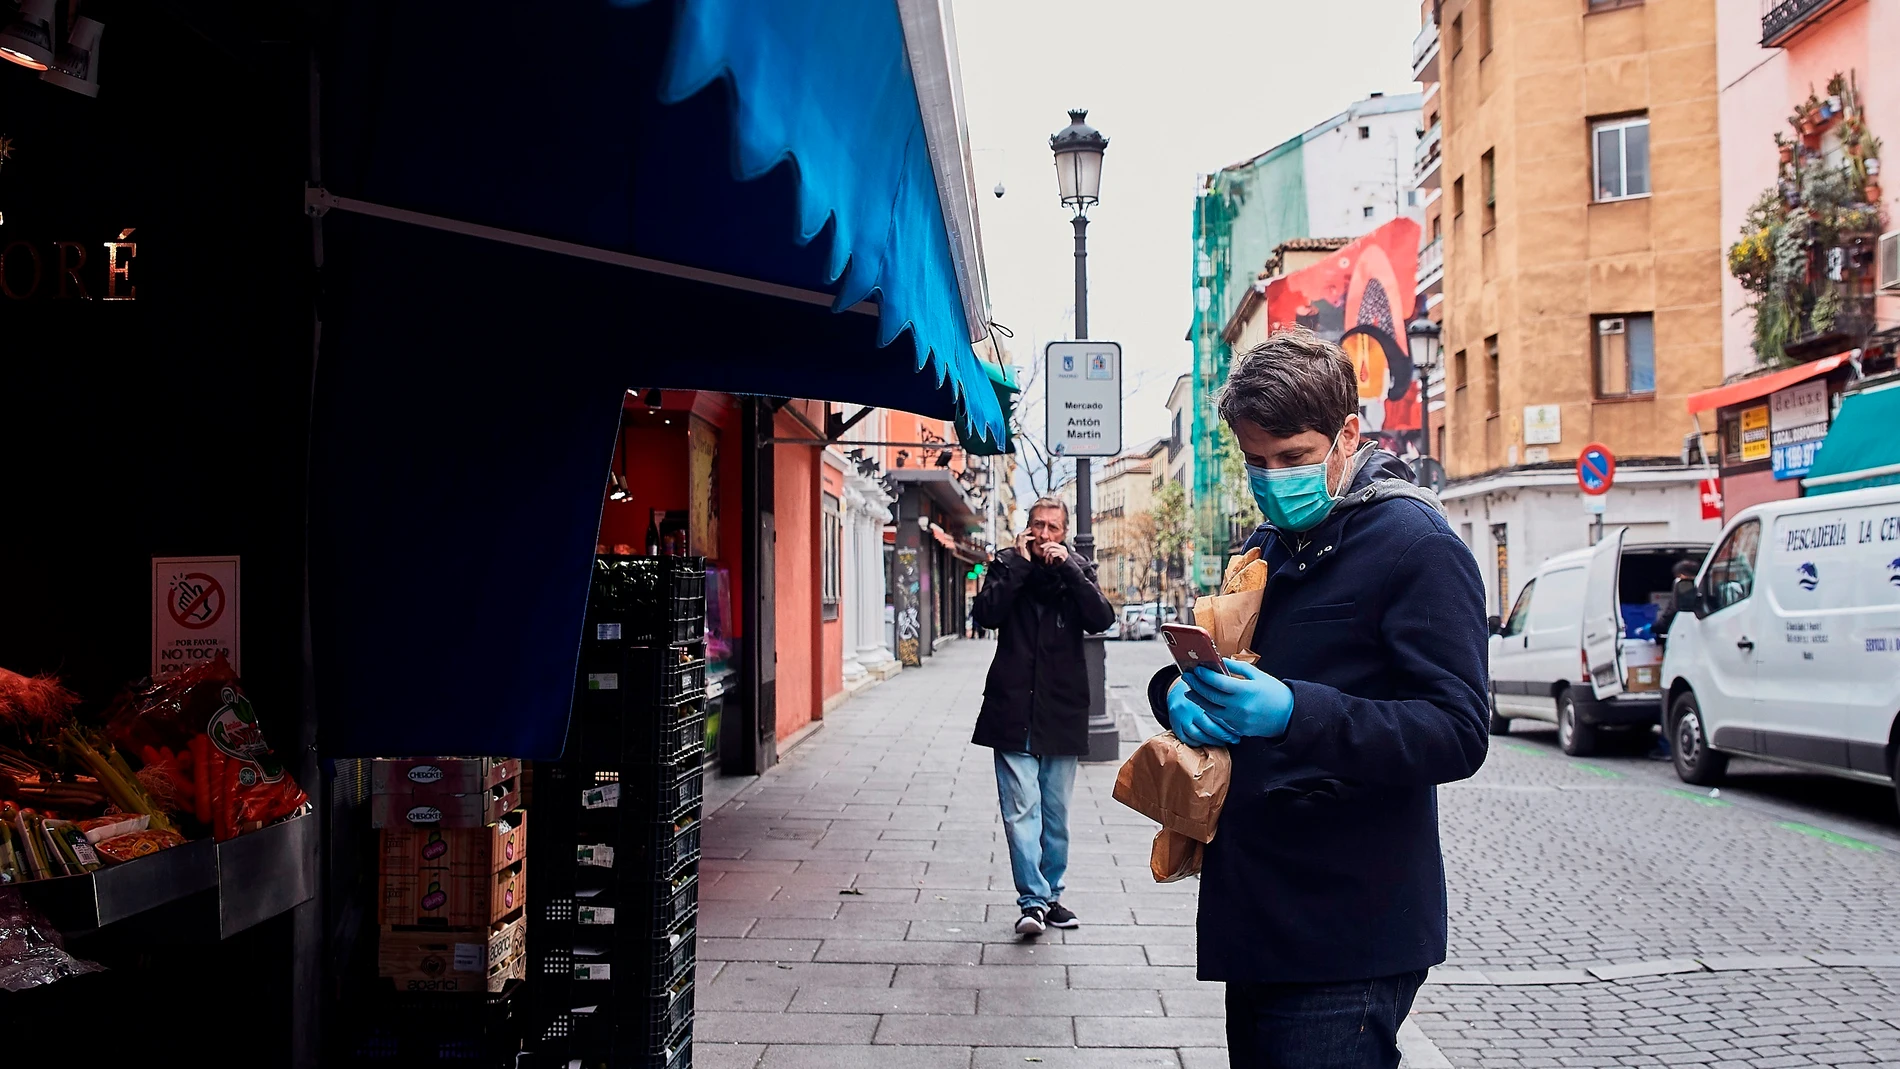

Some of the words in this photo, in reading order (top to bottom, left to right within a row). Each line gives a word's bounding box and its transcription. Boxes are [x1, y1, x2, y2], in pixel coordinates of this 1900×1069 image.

[1065, 401, 1103, 410] Mercado
[1774, 391, 1823, 411] deluxe
[1067, 417, 1101, 427] Antón
[1786, 518, 1847, 552] PESCADERÍA
[1858, 520, 1873, 544] LA
[193, 638, 218, 646] FAVOR
[161, 648, 183, 660] NO
[426, 845, 445, 857] plump
[425, 895, 444, 908] plump
[407, 978, 458, 991] aparici
